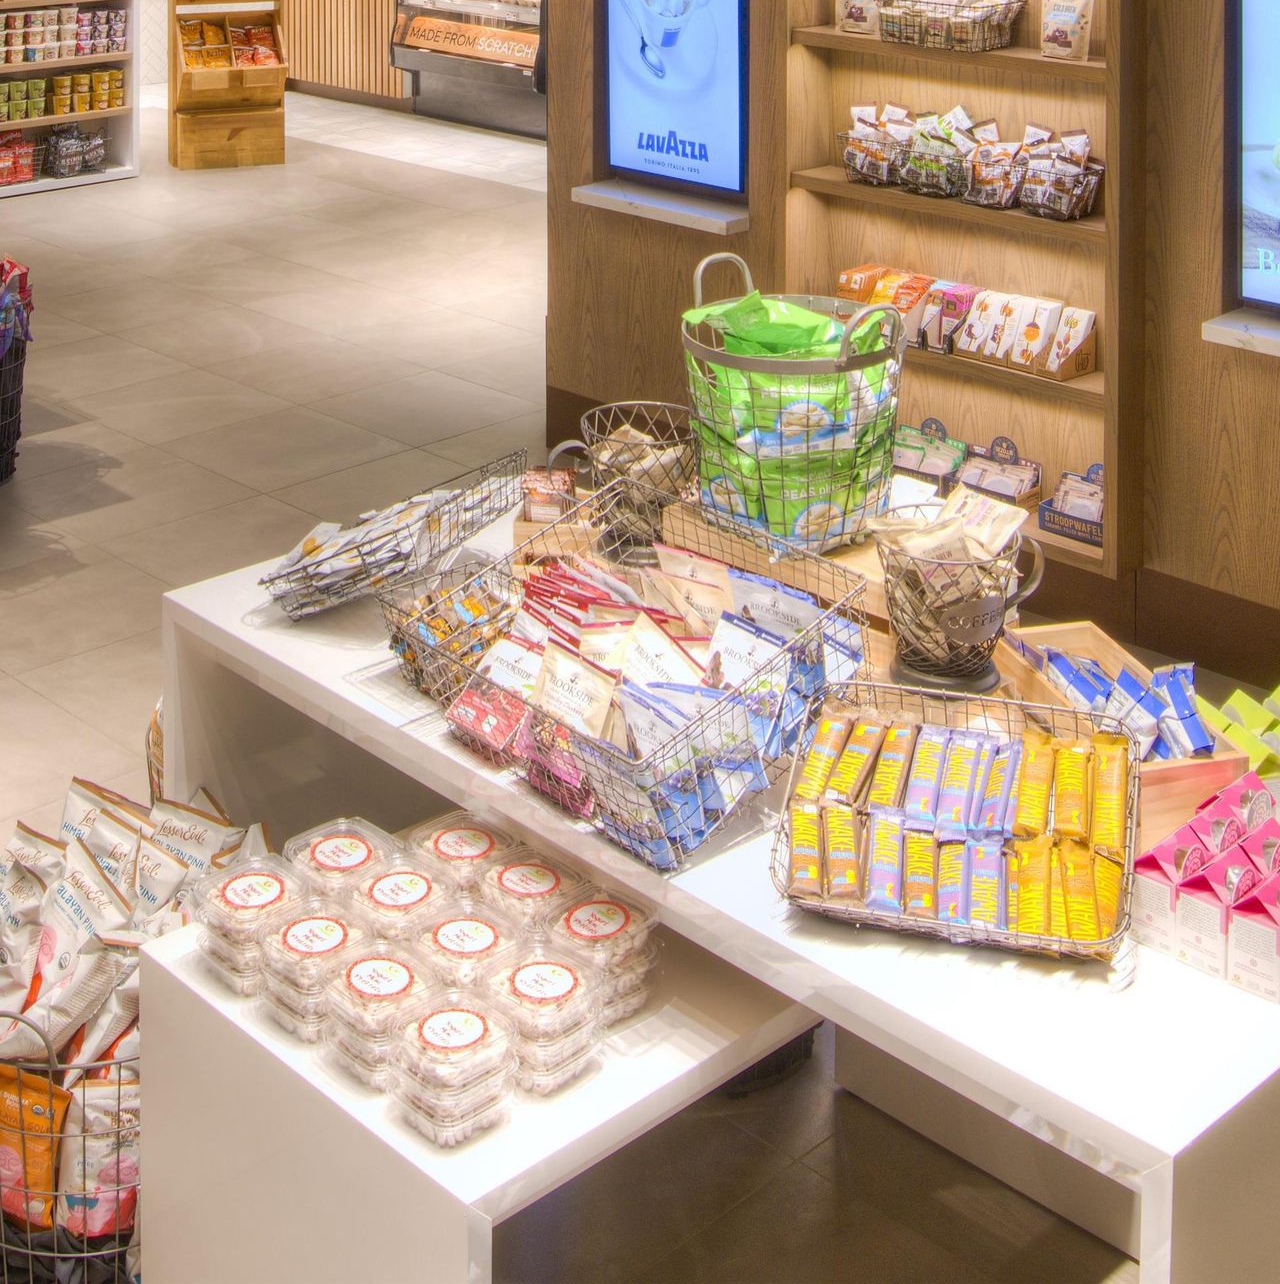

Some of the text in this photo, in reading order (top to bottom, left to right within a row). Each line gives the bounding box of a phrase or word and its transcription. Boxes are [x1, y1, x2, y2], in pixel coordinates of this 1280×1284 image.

[410, 28, 533, 57] MADE FROM SCRATCH
[638, 130, 709, 162] LAVAZZA
[644, 158, 666, 167] TORINO
[750, 602, 801, 625] BROOKSIDE
[796, 747, 837, 799] AWAKE
[827, 750, 868, 798] AWAKE
[871, 759, 904, 806] AWAKE
[793, 807, 818, 849] AWAKE
[827, 807, 856, 853] AWAKE
[186, 856, 206, 871] PINK
